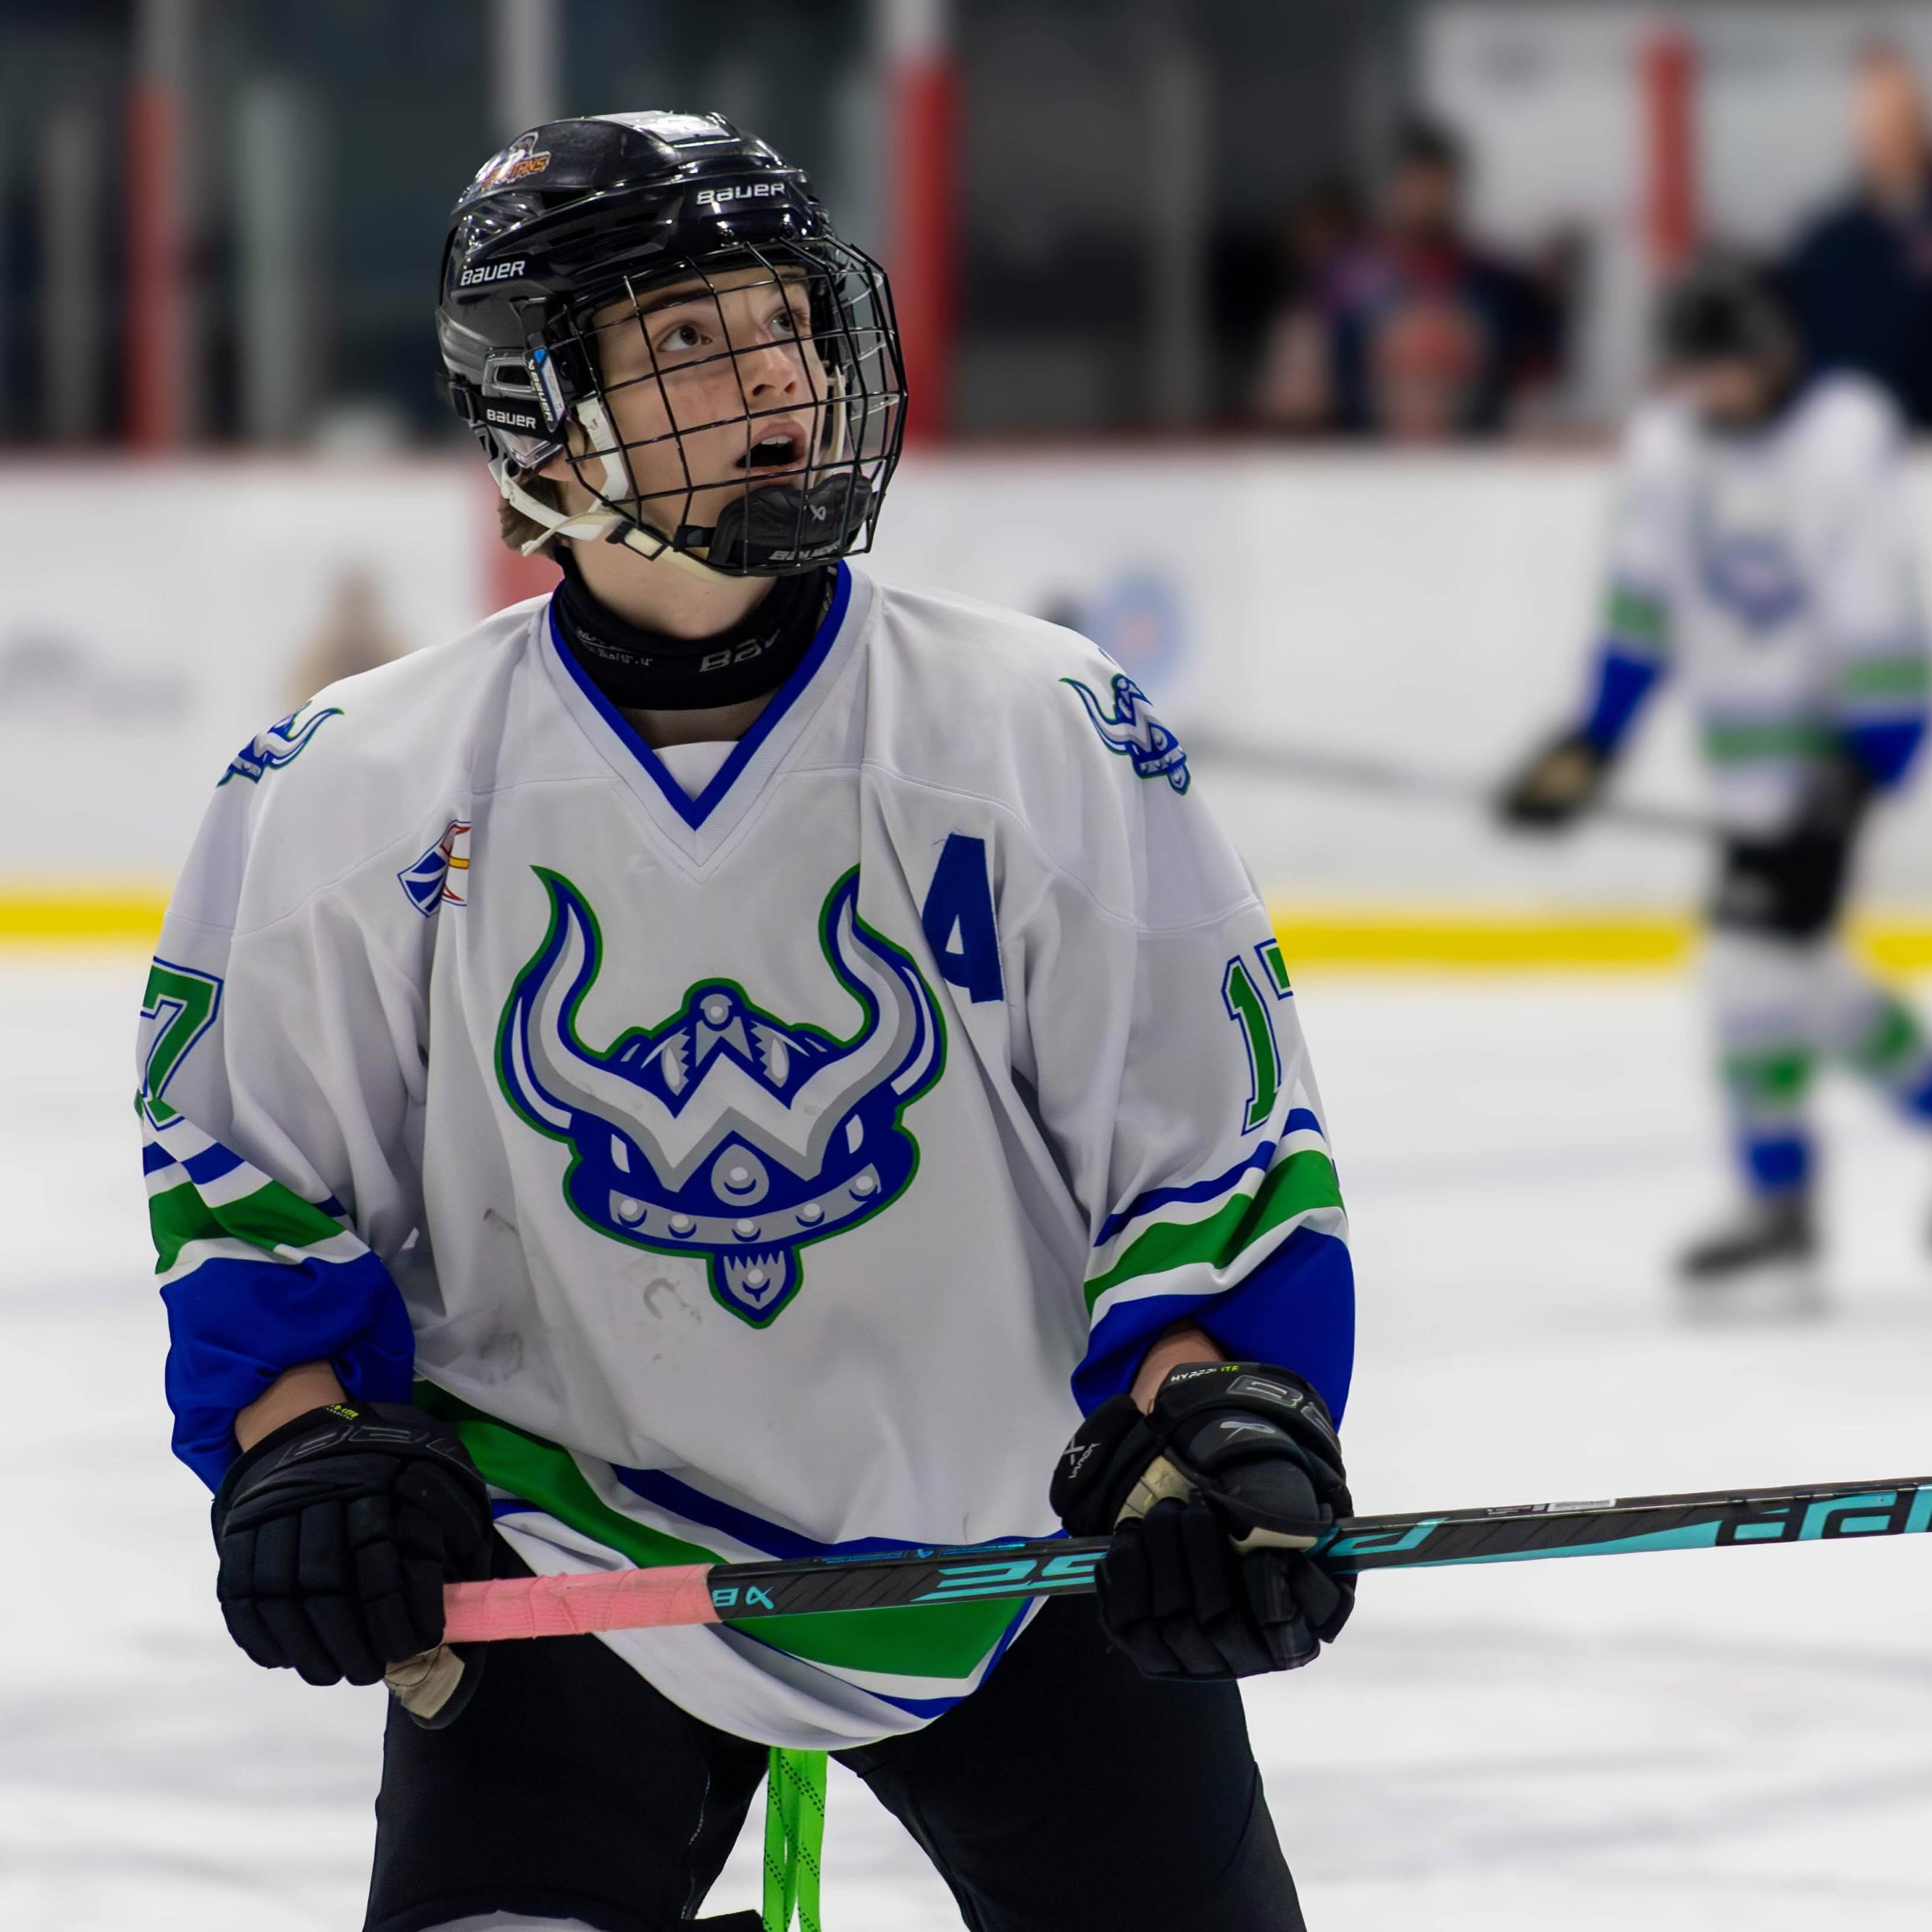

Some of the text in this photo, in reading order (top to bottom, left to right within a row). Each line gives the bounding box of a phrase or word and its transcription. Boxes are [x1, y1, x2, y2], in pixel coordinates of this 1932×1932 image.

[696, 182, 787, 206] BAUER
[460, 260, 526, 287] BAUER
[486, 408, 537, 430] BAUER
[922, 833, 1003, 1003] A
[1171, 1365, 1240, 1382] HYPERITE
